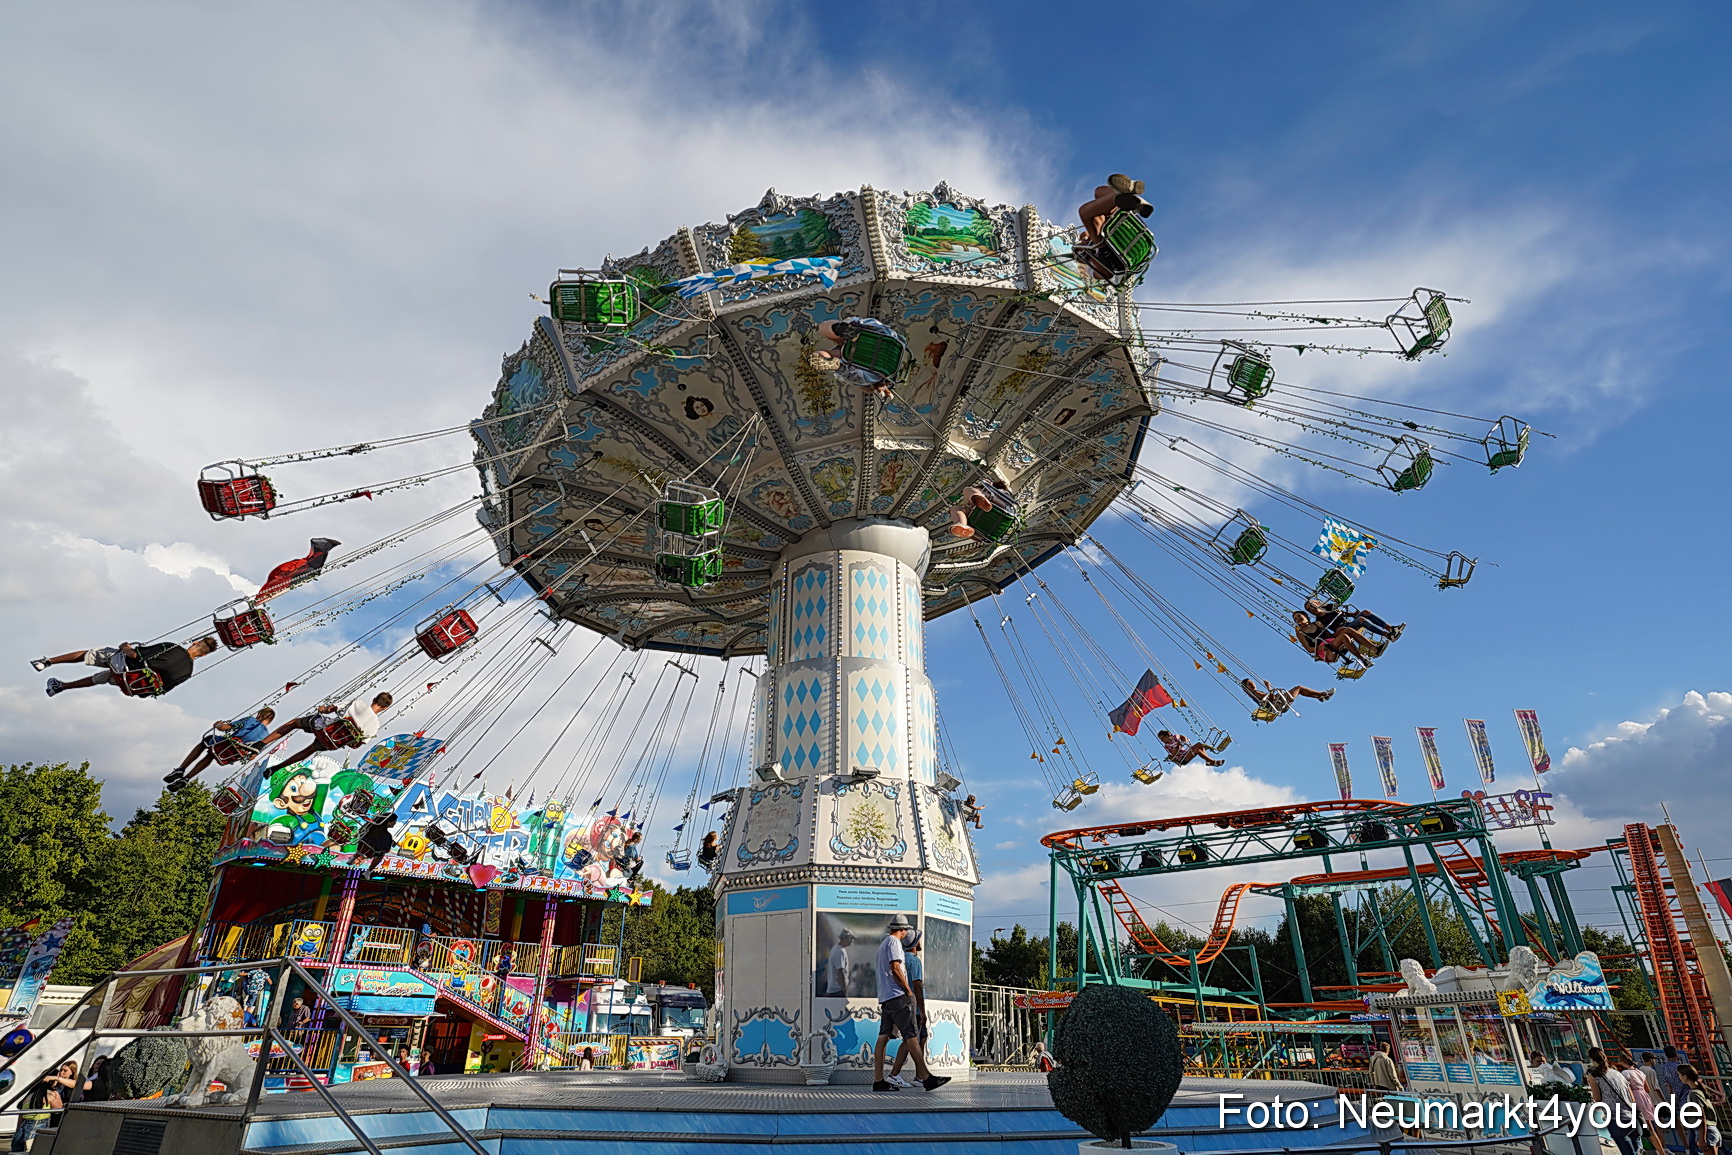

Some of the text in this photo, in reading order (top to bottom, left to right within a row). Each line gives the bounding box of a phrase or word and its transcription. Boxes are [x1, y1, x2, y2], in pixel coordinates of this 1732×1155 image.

[391, 781, 494, 845] ACTION
[361, 970, 393, 980] FAMILY
[1407, 1045, 1420, 1057] 112
